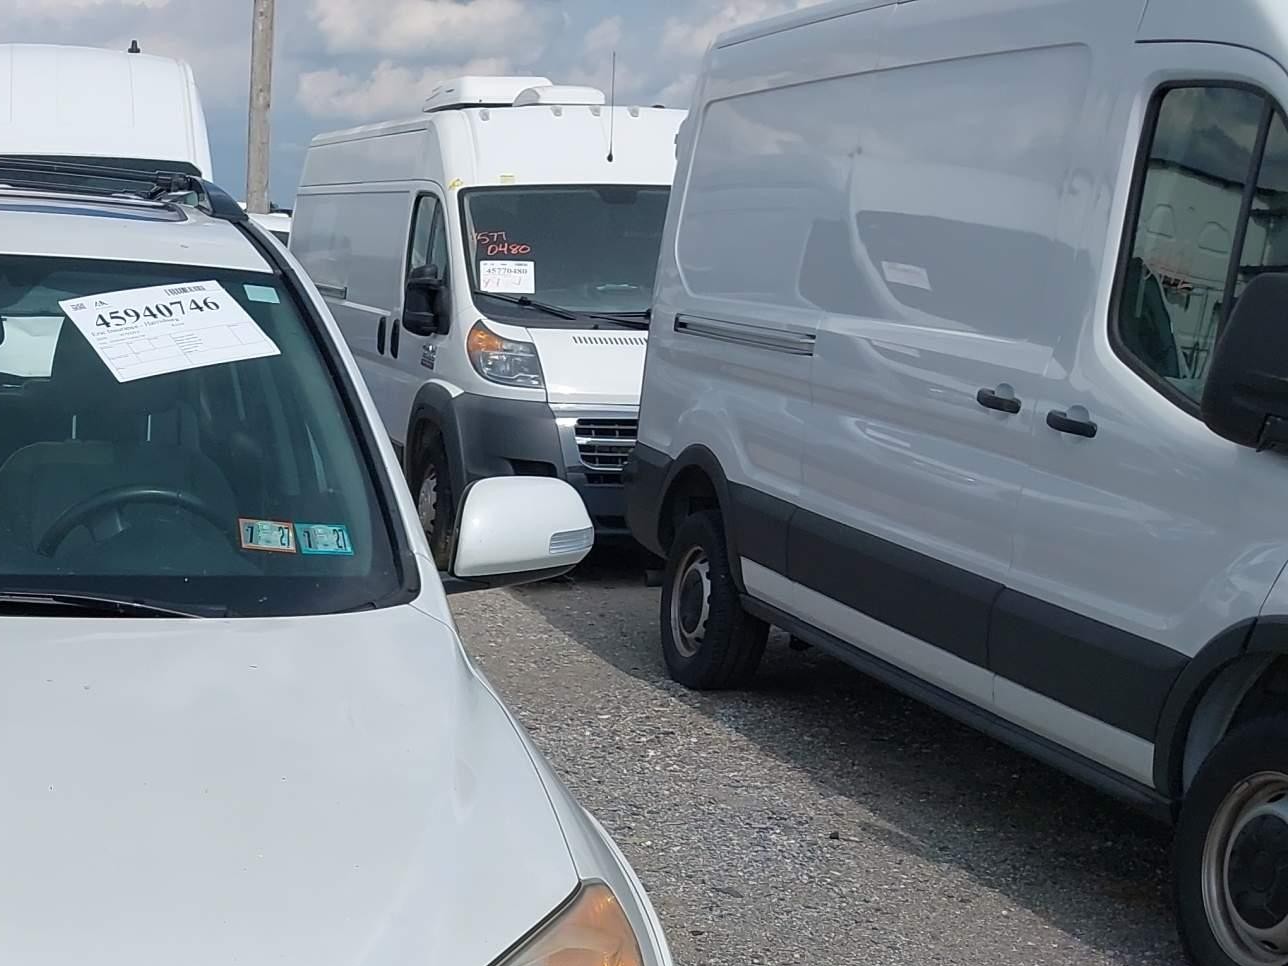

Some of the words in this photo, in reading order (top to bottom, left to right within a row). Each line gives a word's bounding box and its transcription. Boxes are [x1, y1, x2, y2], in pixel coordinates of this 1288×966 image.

[487, 243, 531, 256] 0480
[95, 296, 220, 329] 45940746
[245, 526, 254, 543] 7
[303, 530, 312, 548] 7
